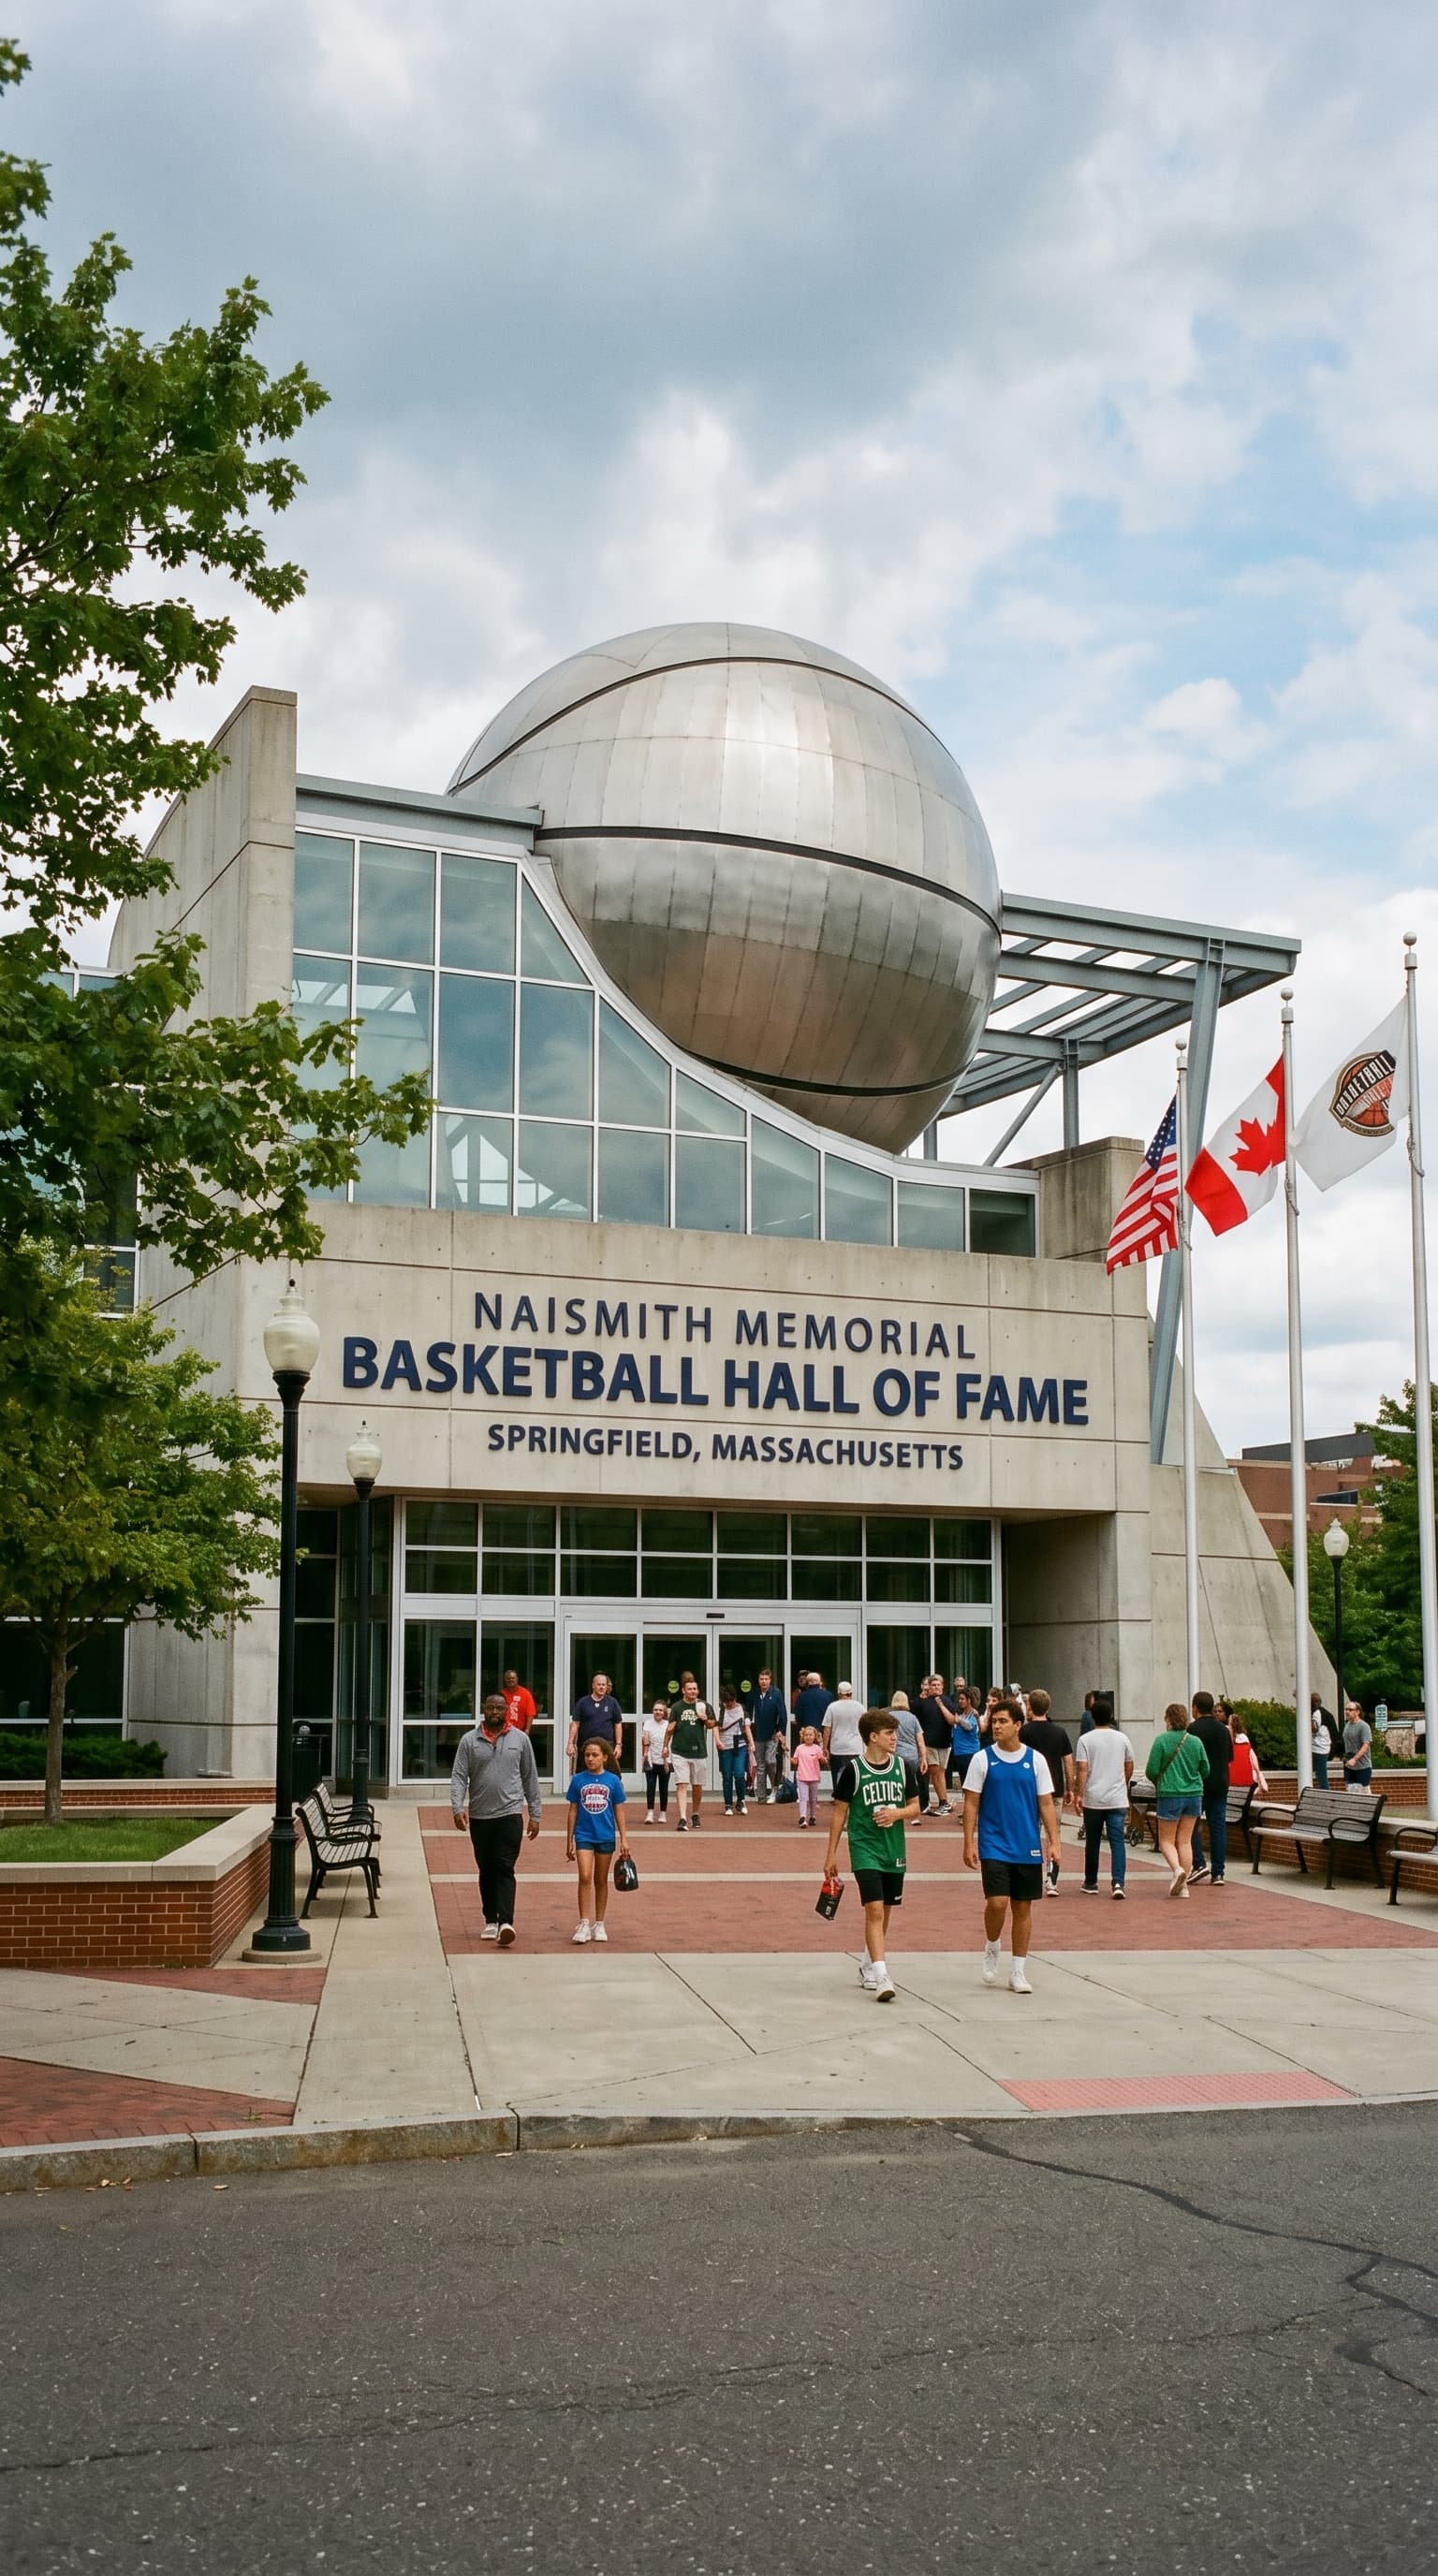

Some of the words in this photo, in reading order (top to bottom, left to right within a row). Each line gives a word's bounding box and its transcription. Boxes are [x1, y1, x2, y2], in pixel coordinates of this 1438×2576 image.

[474, 1291, 712, 1341] NAISMITH
[731, 1309, 976, 1359] MEMORIAL
[342, 1336, 710, 1406] BASKETBALL
[724, 1358, 860, 1414] HALL
[868, 1368, 940, 1417] OF
[955, 1371, 1090, 1426] FAME
[488, 1423, 700, 1463] SPRINGFIELD,
[712, 1435, 965, 1471] MASSACHUSETTS
[862, 1780, 903, 1806] CELTICS
